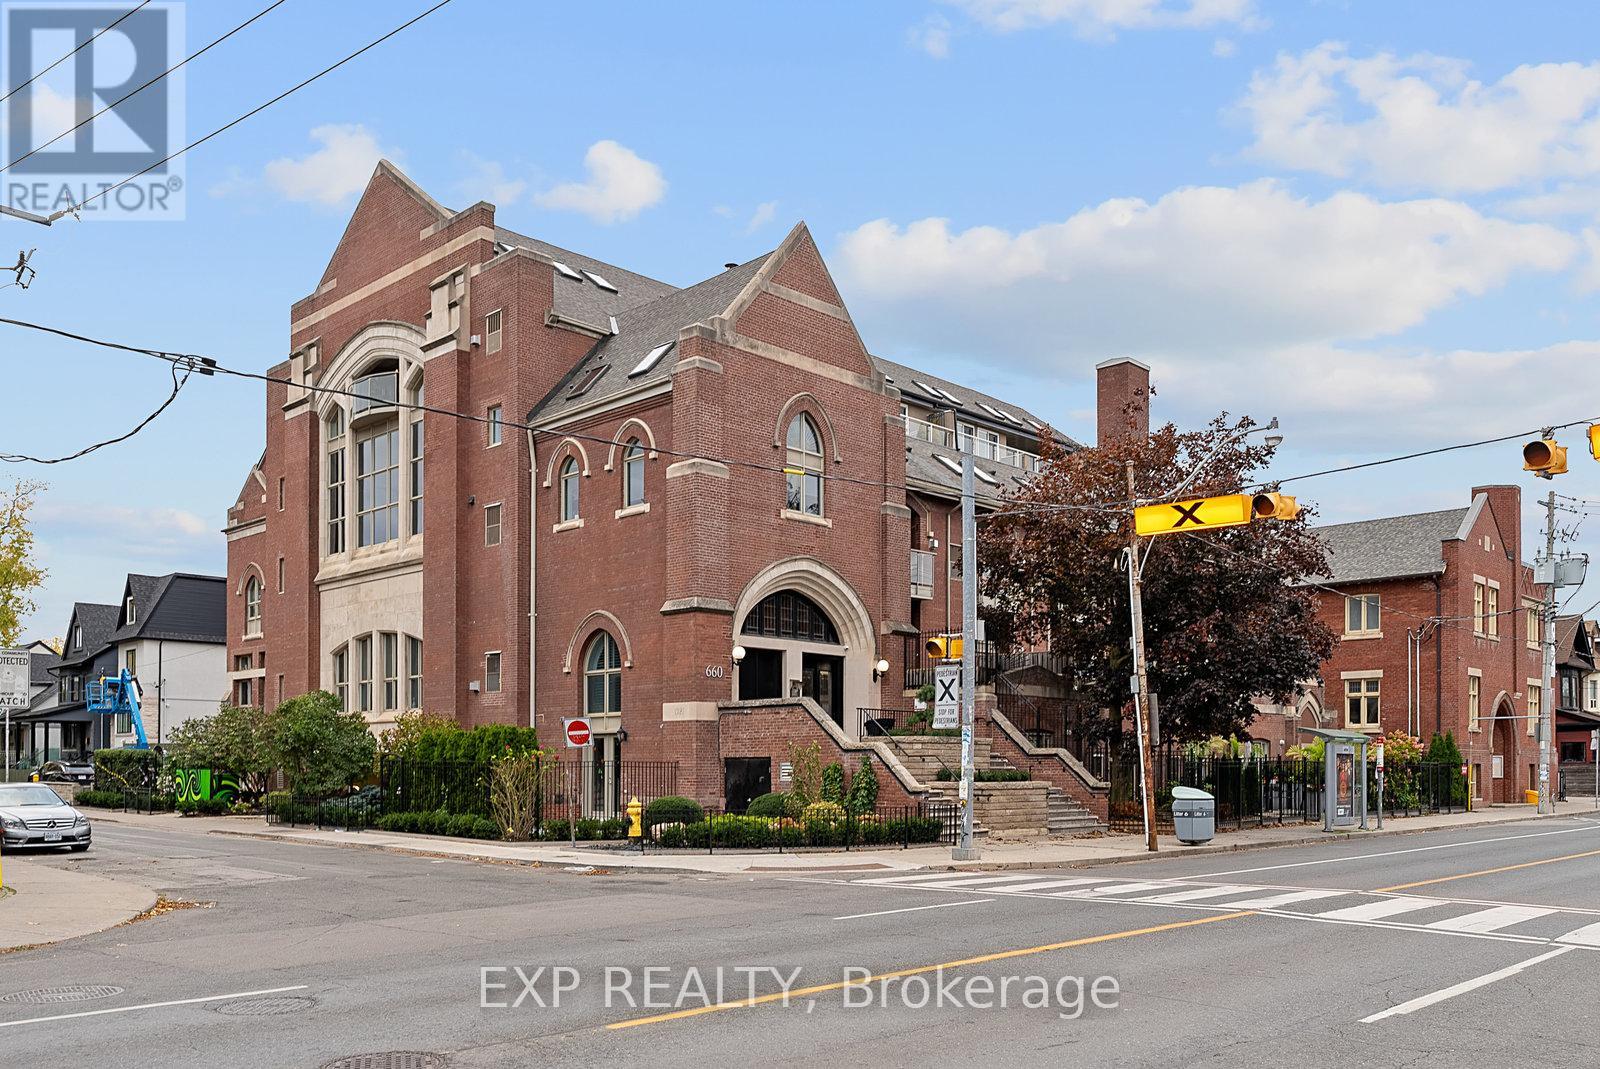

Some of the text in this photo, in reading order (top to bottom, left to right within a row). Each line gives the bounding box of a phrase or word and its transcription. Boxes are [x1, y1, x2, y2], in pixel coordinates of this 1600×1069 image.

[1171, 501, 1206, 528] X
[705, 665, 723, 678] 660
[938, 678, 956, 701] X
